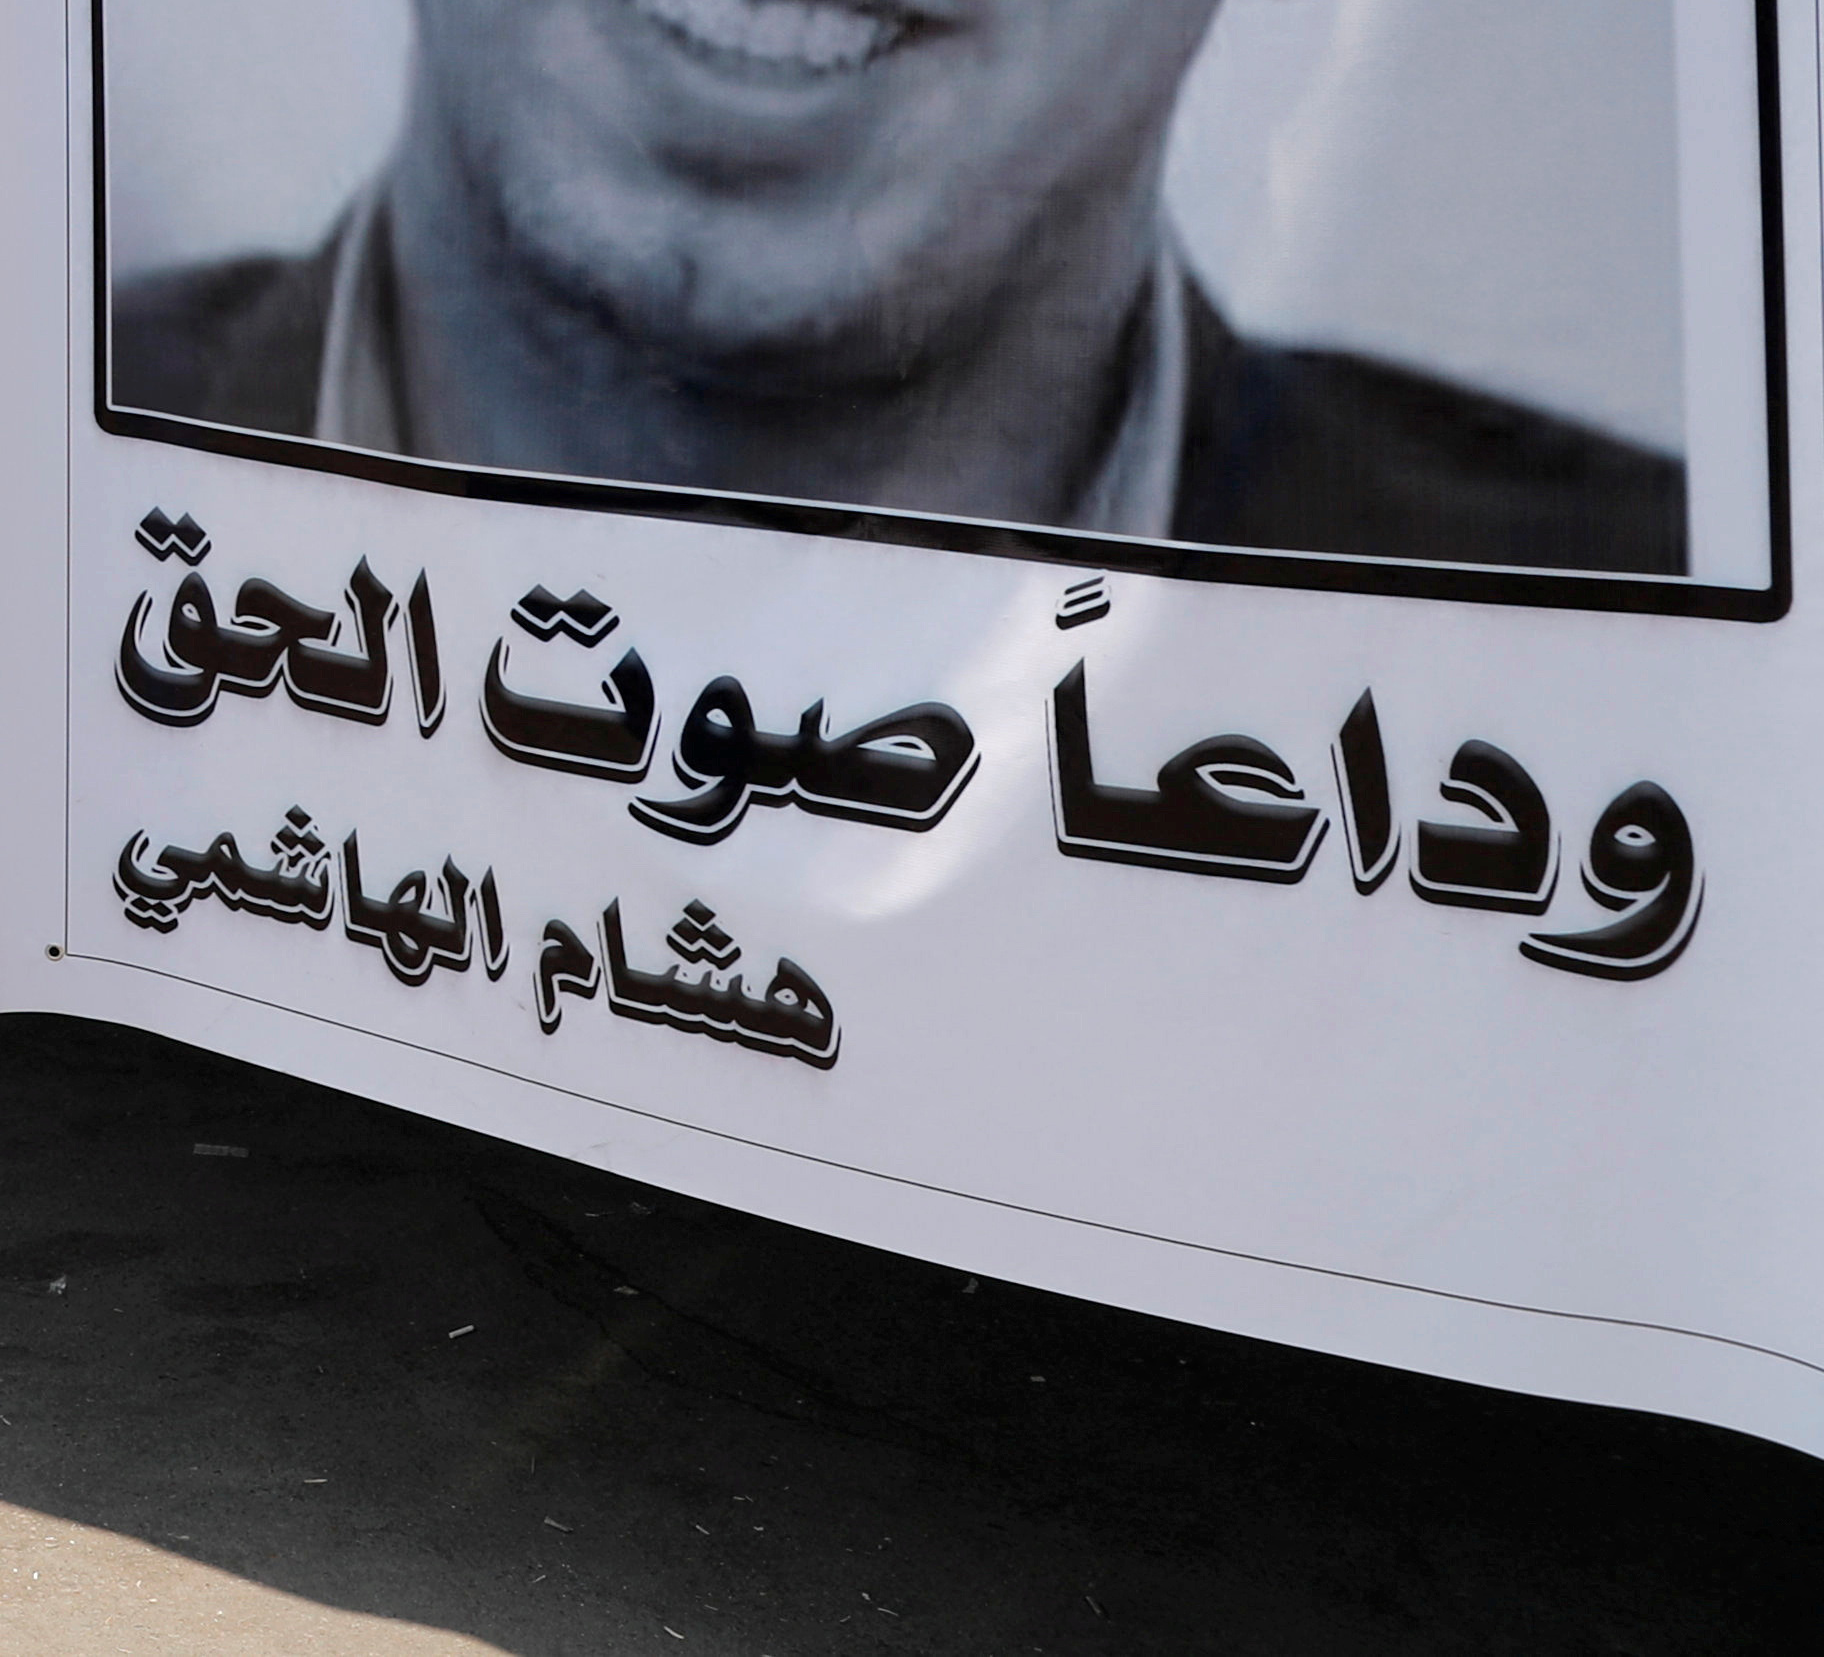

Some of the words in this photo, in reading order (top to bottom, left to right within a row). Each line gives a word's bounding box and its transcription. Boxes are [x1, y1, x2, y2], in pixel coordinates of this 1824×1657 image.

[114, 506, 448, 740] الحق
[478, 585, 981, 847] صوت
[112, 804, 508, 982] الهاشمي
[530, 898, 842, 1071] هشام
